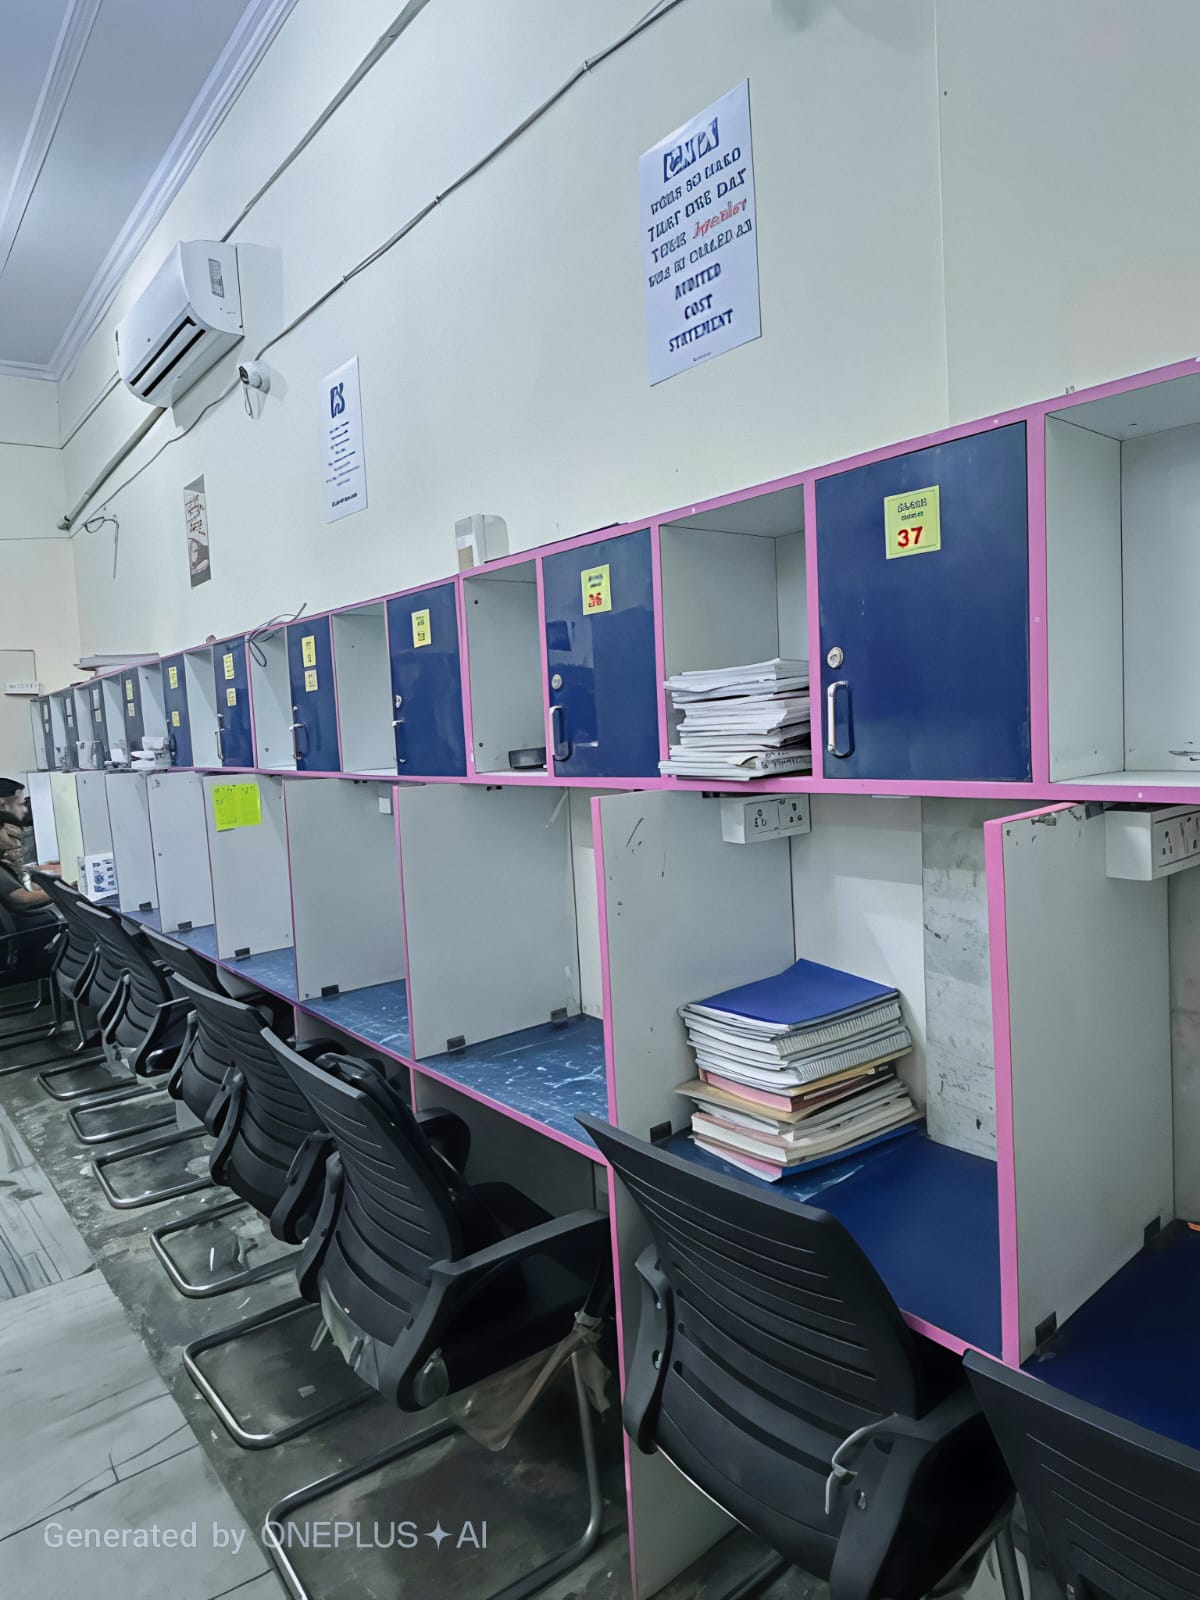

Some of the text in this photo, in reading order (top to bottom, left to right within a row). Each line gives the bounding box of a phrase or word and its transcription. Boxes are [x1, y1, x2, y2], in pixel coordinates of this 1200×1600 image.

[684, 293, 713, 320] COST
[668, 308, 734, 352] STATEMENT
[897, 526, 923, 548] 37
